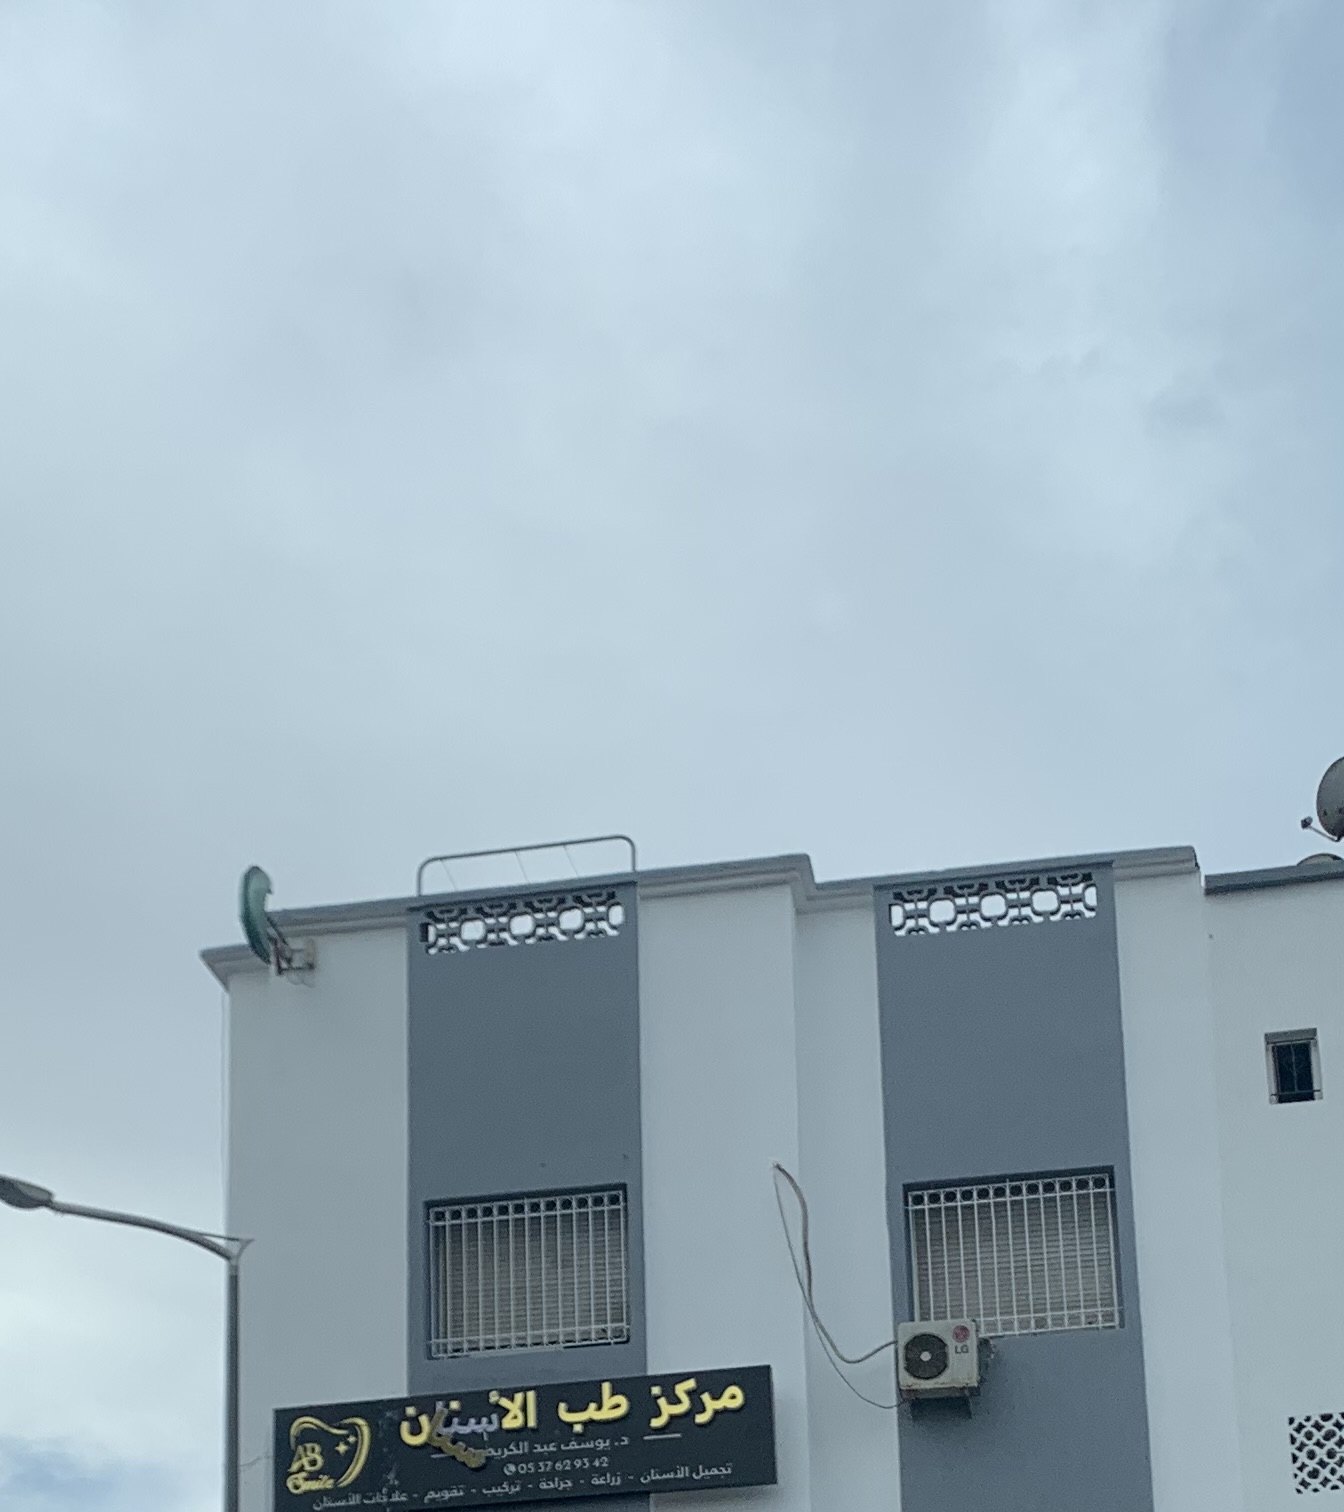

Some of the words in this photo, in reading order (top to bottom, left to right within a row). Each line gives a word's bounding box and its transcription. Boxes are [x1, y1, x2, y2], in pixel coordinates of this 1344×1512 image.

[557, 1381, 630, 1434] طب
[649, 1377, 746, 1429] مركز
[533, 1441, 558, 1454] عبد
[560, 1437, 611, 1453] يوسف
[518, 1463, 535, 1474] 05
[537, 1462, 554, 1473] 37
[555, 1460, 572, 1471] 62
[573, 1458, 590, 1470] 93
[592, 1456, 609, 1468] 42
[692, 1462, 733, 1480] تجميل
[539, 1477, 573, 1491] جراحة
[590, 1472, 623, 1486] زراعة
[640, 1466, 690, 1484] الأسنان
[423, 1484, 466, 1503] تقويم
